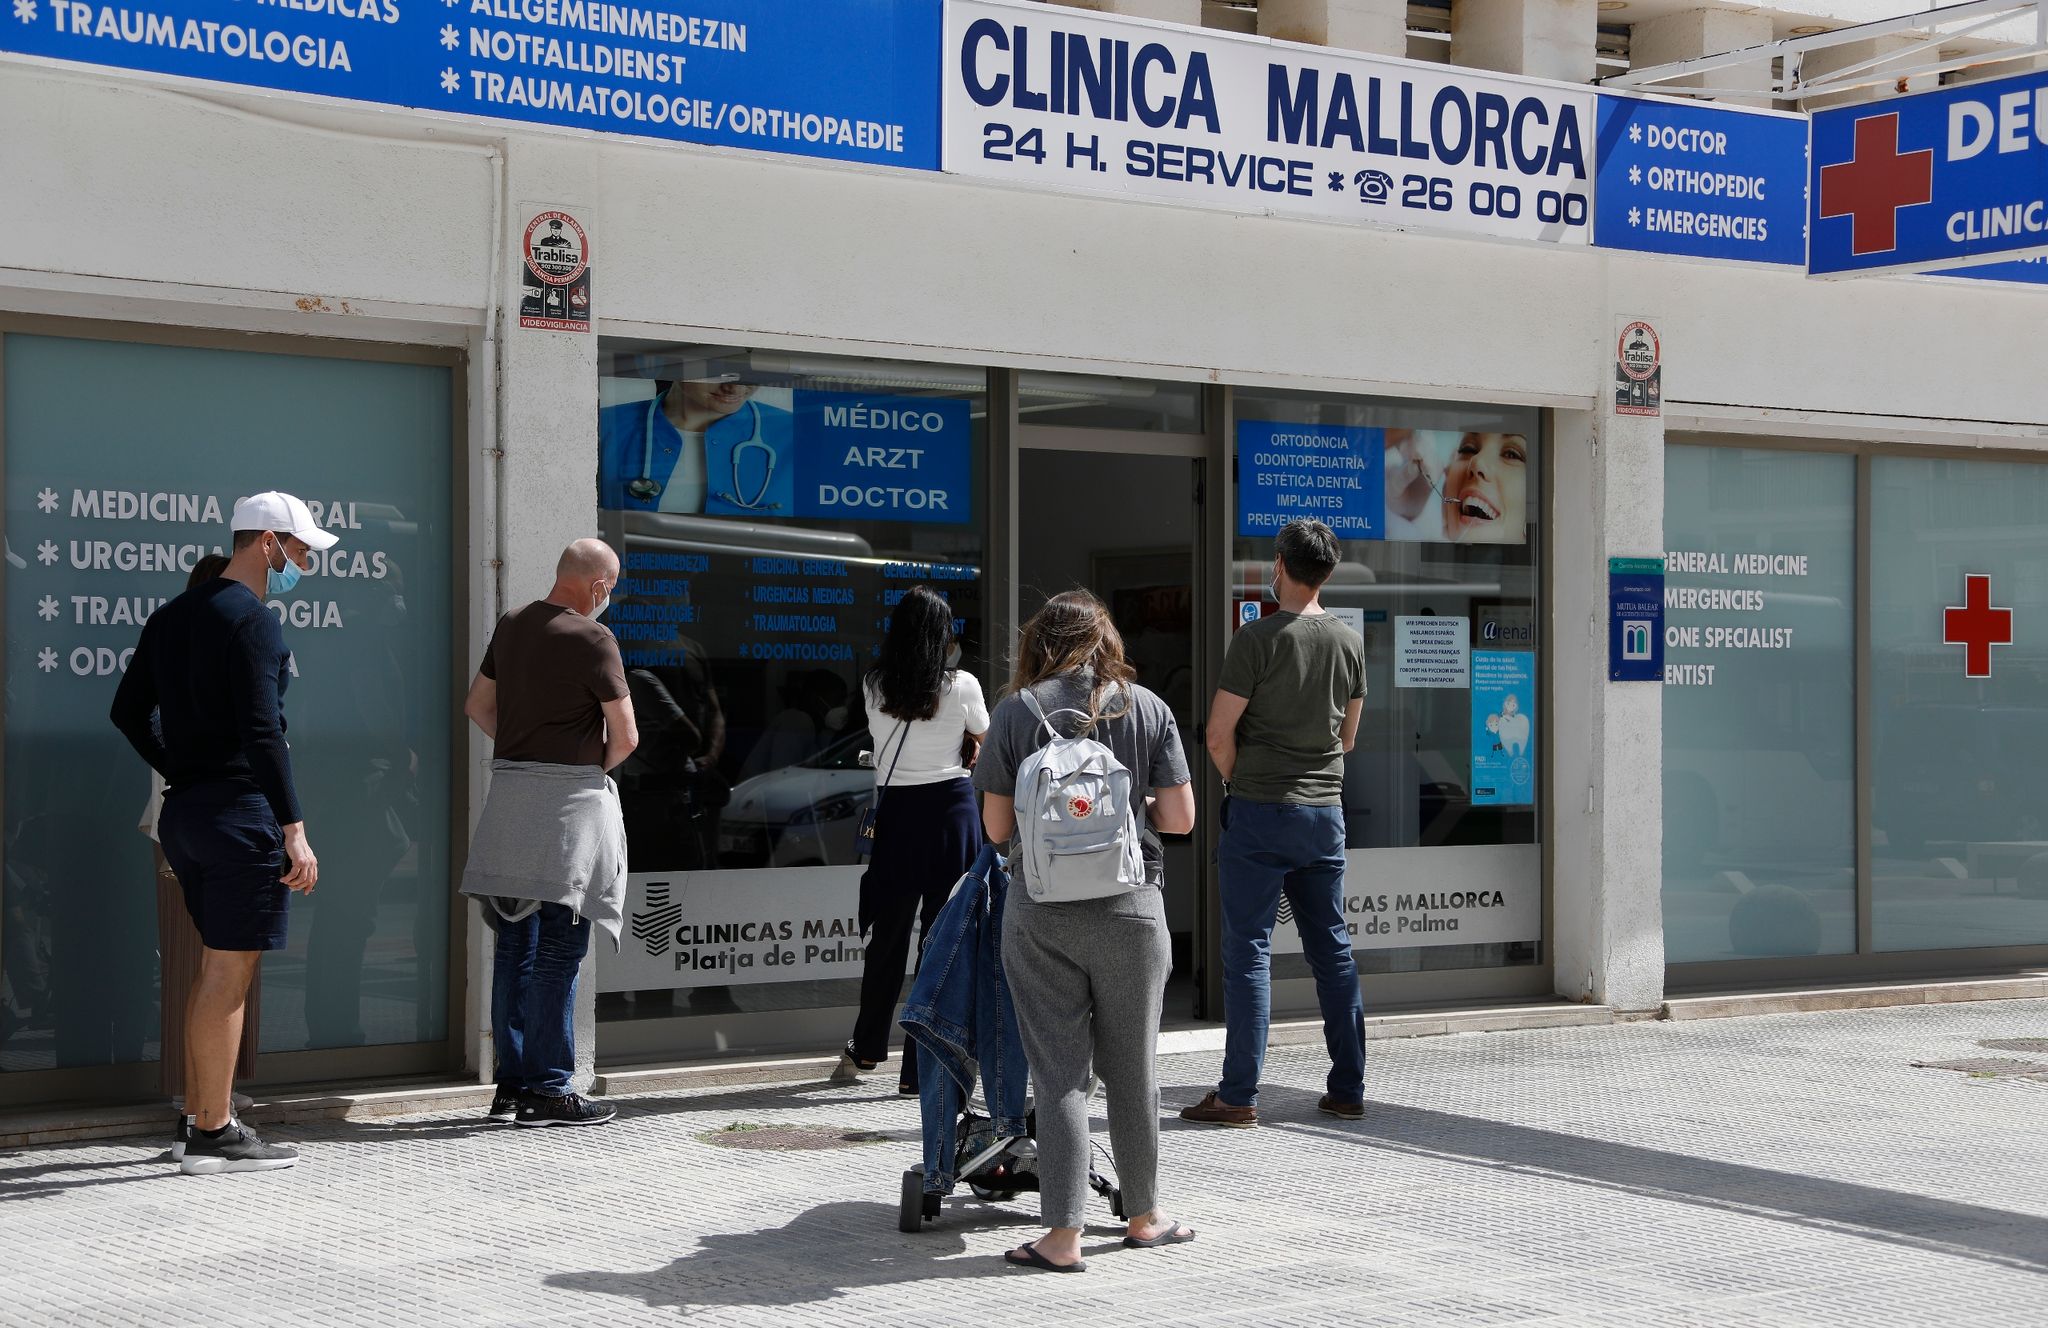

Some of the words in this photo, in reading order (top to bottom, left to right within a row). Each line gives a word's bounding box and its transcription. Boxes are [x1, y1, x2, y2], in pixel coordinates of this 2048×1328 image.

[54, 0, 352, 72] TRAUMATOLOGIA
[470, 0, 747, 53] ALLGEMEINMEDEZIN
[470, 27, 686, 84] NOTFALLDIENST
[470, 69, 903, 153] TRAUMATOLOGIE/ORTHOPAEDIE
[961, 18, 1221, 134] CLINICA
[1268, 63, 1587, 181] MALLORCA
[1647, 124, 1727, 156] DOCTOR
[983, 122, 1047, 165] 24
[1066, 132, 1107, 172] H.
[1126, 140, 1314, 197] SERVICE
[1402, 174, 1453, 212] 26
[1469, 180, 1521, 220] 00
[1537, 189, 1588, 226] 00
[1647, 166, 1766, 200] ORTHOPEDIC
[1646, 208, 1768, 242] EMERGENCIES
[1946, 200, 2048, 243] CLINIC
[532, 246, 579, 264] Trablisa
[522, 318, 589, 331] VIDEOVIGILANCIA
[1624, 350, 1654, 363] Trablisa
[823, 402, 944, 433] MÉDICO
[1271, 433, 1349, 450] ORTODONCIA
[843, 446, 925, 470] ARZT
[1254, 452, 1365, 470] ODONTOPEDIATRÍA
[1257, 471, 1315, 488] ESTÉTICA
[1317, 475, 1363, 490] DENTAL
[70, 489, 224, 524] MEDICINA
[819, 484, 948, 511] DOCTOR
[1277, 493, 1343, 509] IMPLANTES
[1326, 515, 1372, 530] DENTAL
[301, 548, 388, 580] DICAS
[752, 556, 799, 576] MEDICINA
[803, 558, 848, 577] GENERAL
[1733, 553, 1808, 576] MEDICINE
[753, 585, 809, 605] URGENCIAS
[812, 588, 854, 606] MEDICAS
[1616, 602, 1637, 611] MUTUA
[1638, 603, 1659, 612] BALEAR
[1664, 588, 1764, 611] MERGENCIES
[753, 614, 837, 634] TRAUMATOLOGIA
[1483, 621, 1532, 641] arenal
[1665, 626, 1700, 648] ONE
[1705, 626, 1793, 649] SPECIALIST
[752, 643, 855, 662] ODONTOLOGIA
[1665, 664, 1715, 686] ENTIST
[1396, 890, 1505, 912] MALLORCA
[675, 920, 793, 946] CLINICAS
[1365, 915, 1391, 935] de
[1397, 913, 1459, 934] Palma
[674, 945, 754, 975] Platja
[762, 944, 796, 967] de
[804, 940, 866, 965] Palm
